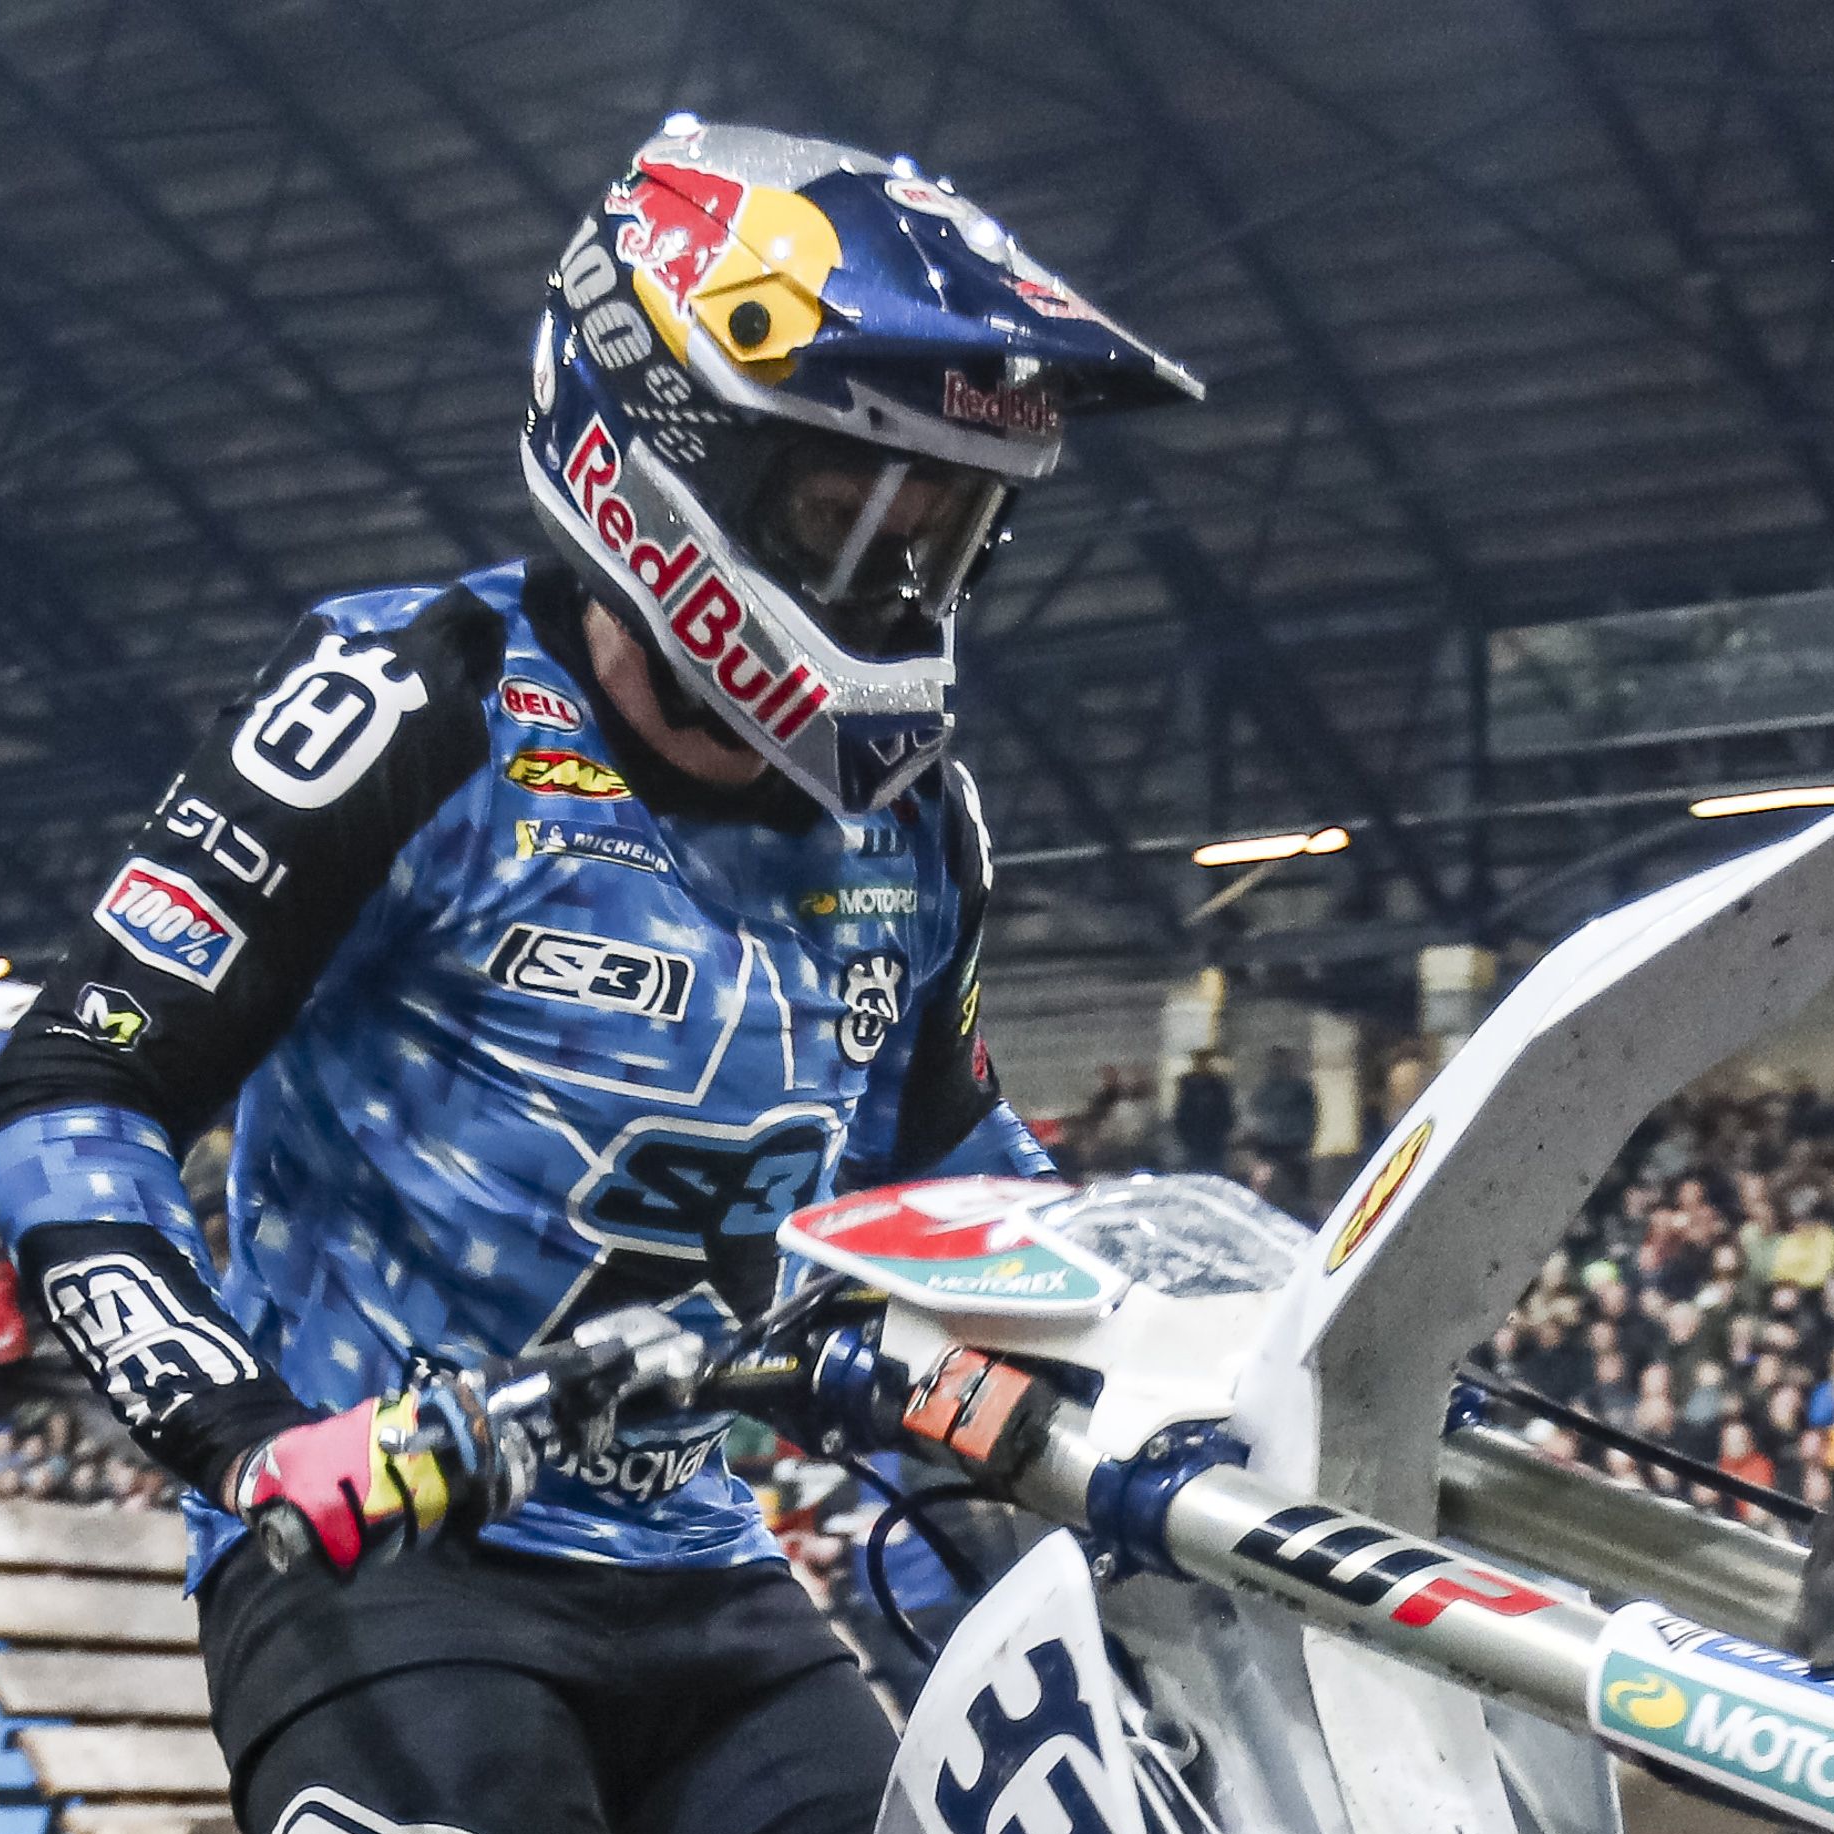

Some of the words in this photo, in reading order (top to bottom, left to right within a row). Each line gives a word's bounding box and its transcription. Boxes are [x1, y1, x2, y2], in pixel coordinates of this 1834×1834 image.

[565, 420, 703, 601] Red
[670, 572, 832, 743] Bull
[503, 685, 577, 726] BELL
[111, 880, 225, 966] 100%
